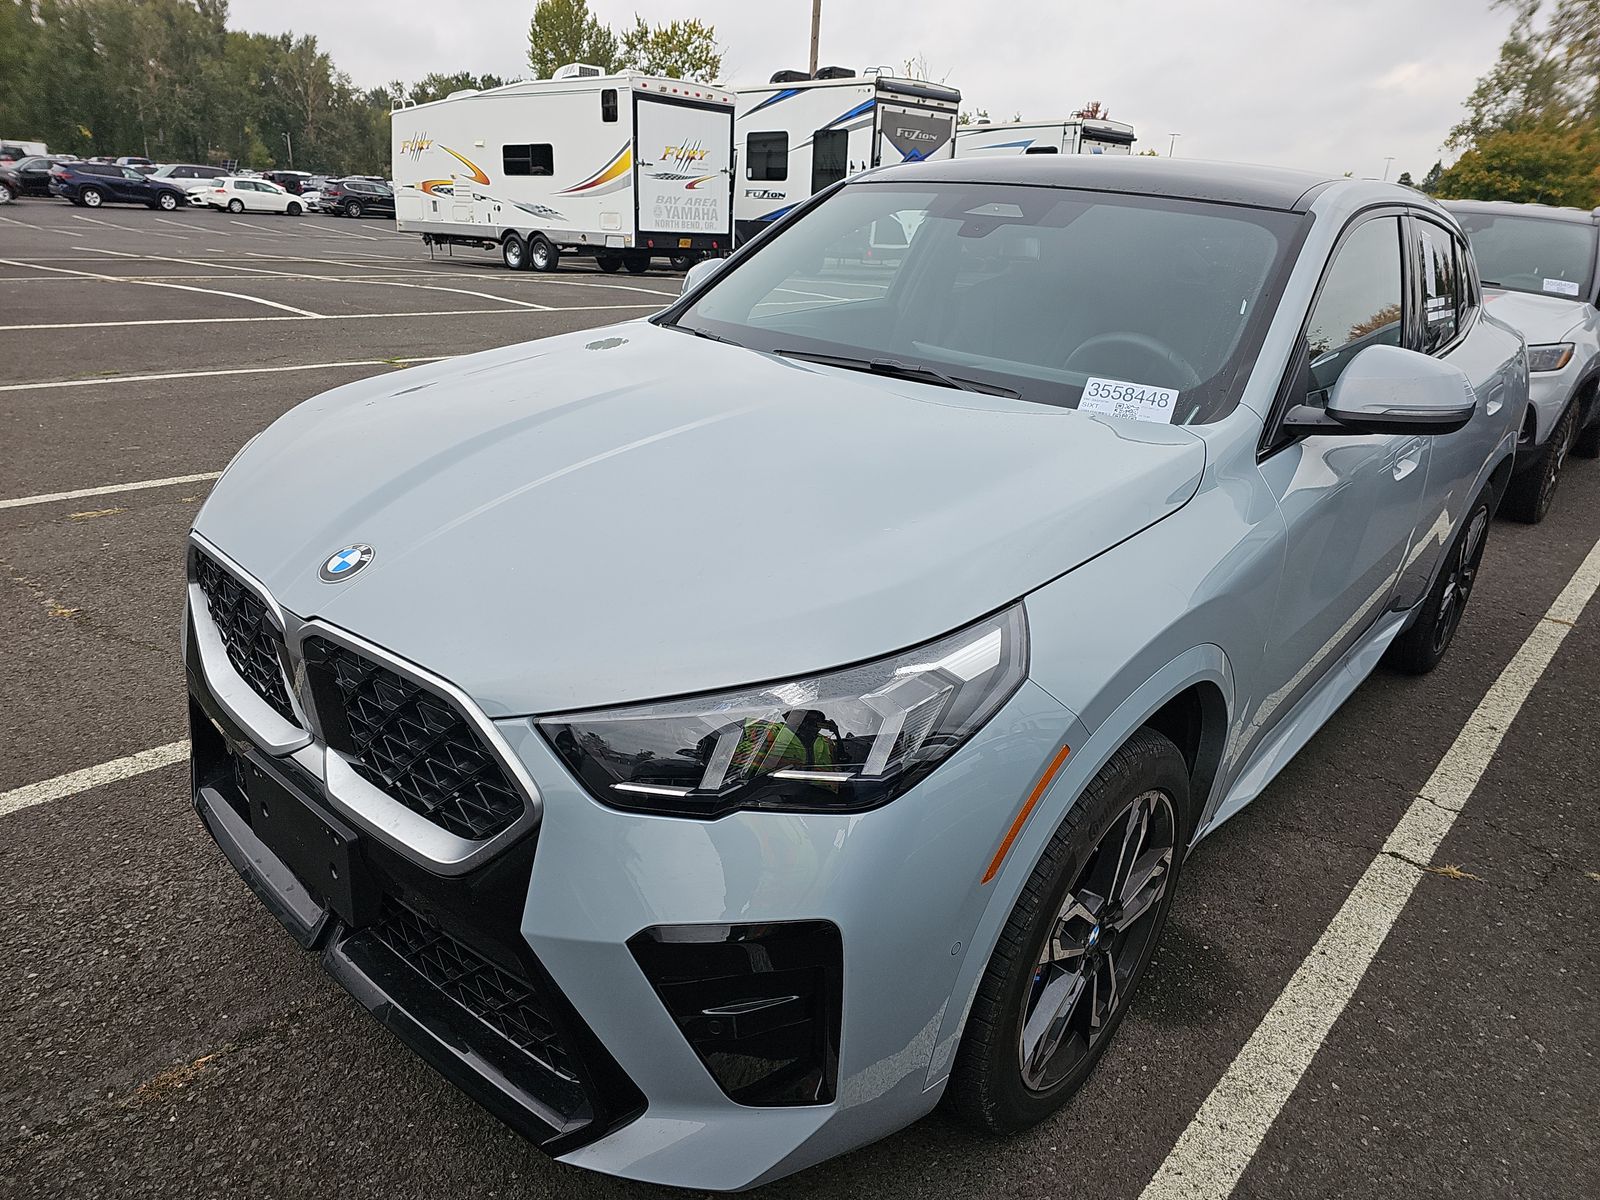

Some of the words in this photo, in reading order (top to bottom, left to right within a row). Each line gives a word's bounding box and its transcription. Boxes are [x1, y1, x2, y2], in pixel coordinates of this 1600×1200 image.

[896, 128, 938, 142] FUZION
[659, 145, 710, 161] FURY
[656, 195, 681, 205] BAY
[684, 197, 718, 207] AREA
[744, 189, 786, 200] FUZION
[664, 206, 719, 221] YAMAHA
[655, 219, 680, 229] NORTH
[681, 220, 703, 230] BEND,
[1088, 382, 1170, 408] 3558448
[1081, 401, 1100, 409] SIXT
